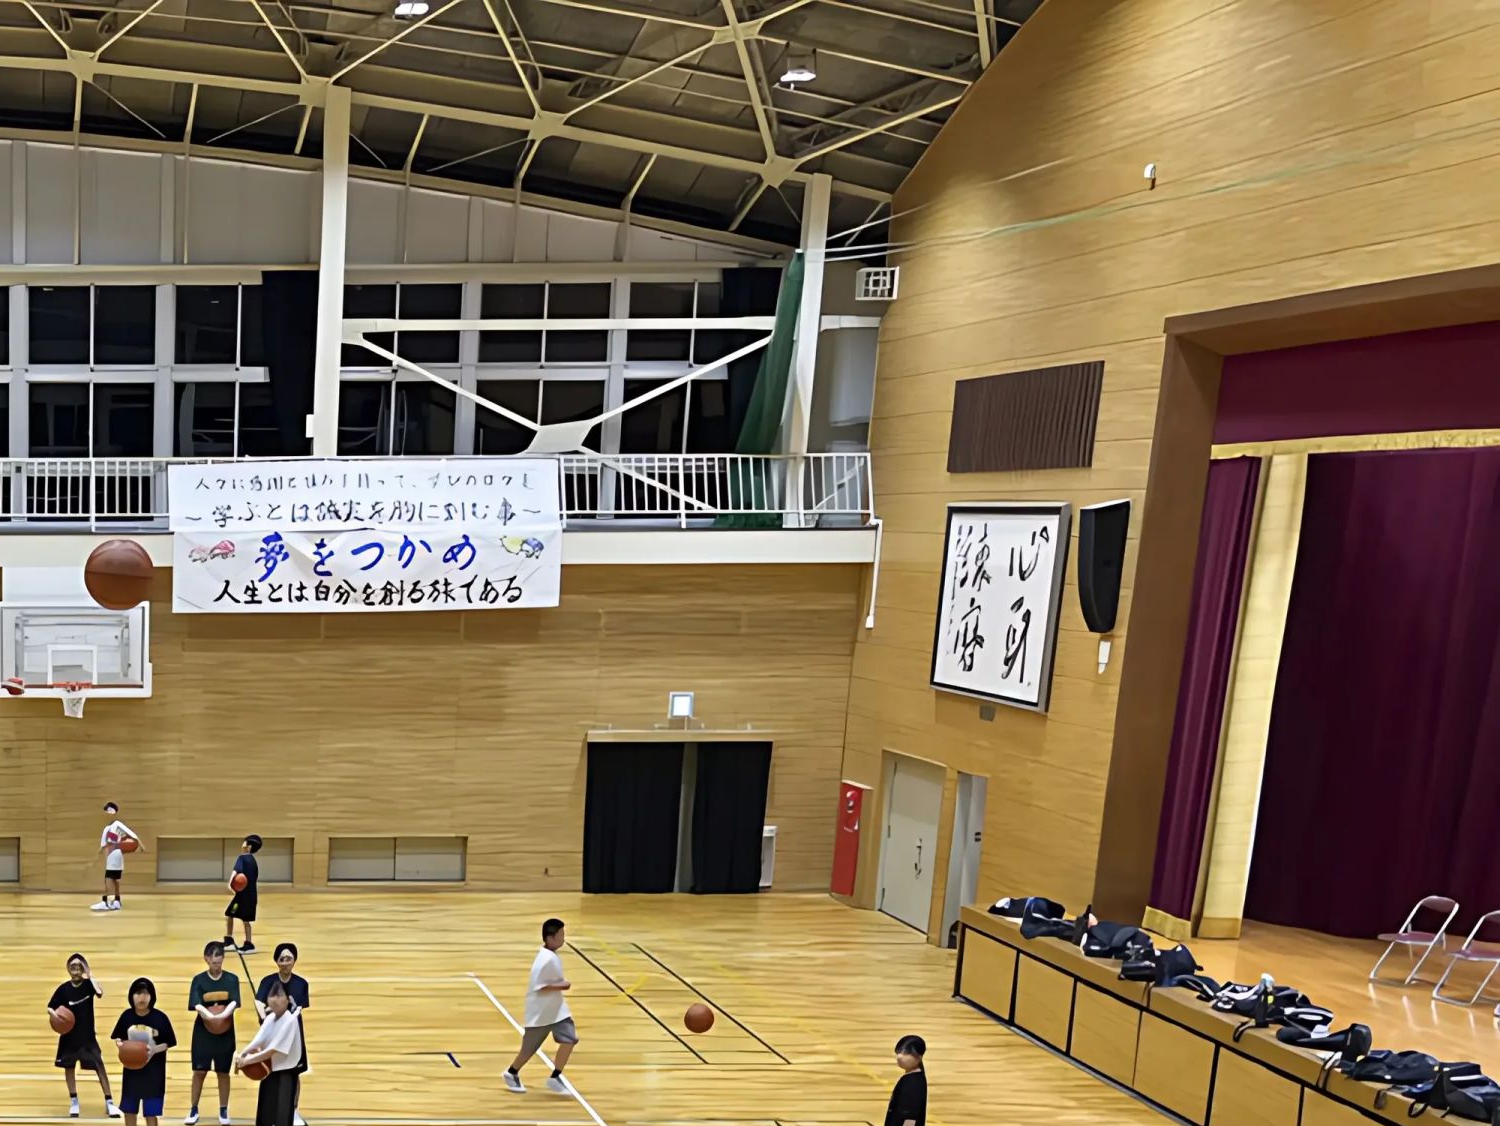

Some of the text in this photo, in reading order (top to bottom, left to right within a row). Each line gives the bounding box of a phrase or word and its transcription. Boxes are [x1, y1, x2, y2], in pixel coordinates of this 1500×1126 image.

[254, 531, 478, 583] 夢をつかめ
